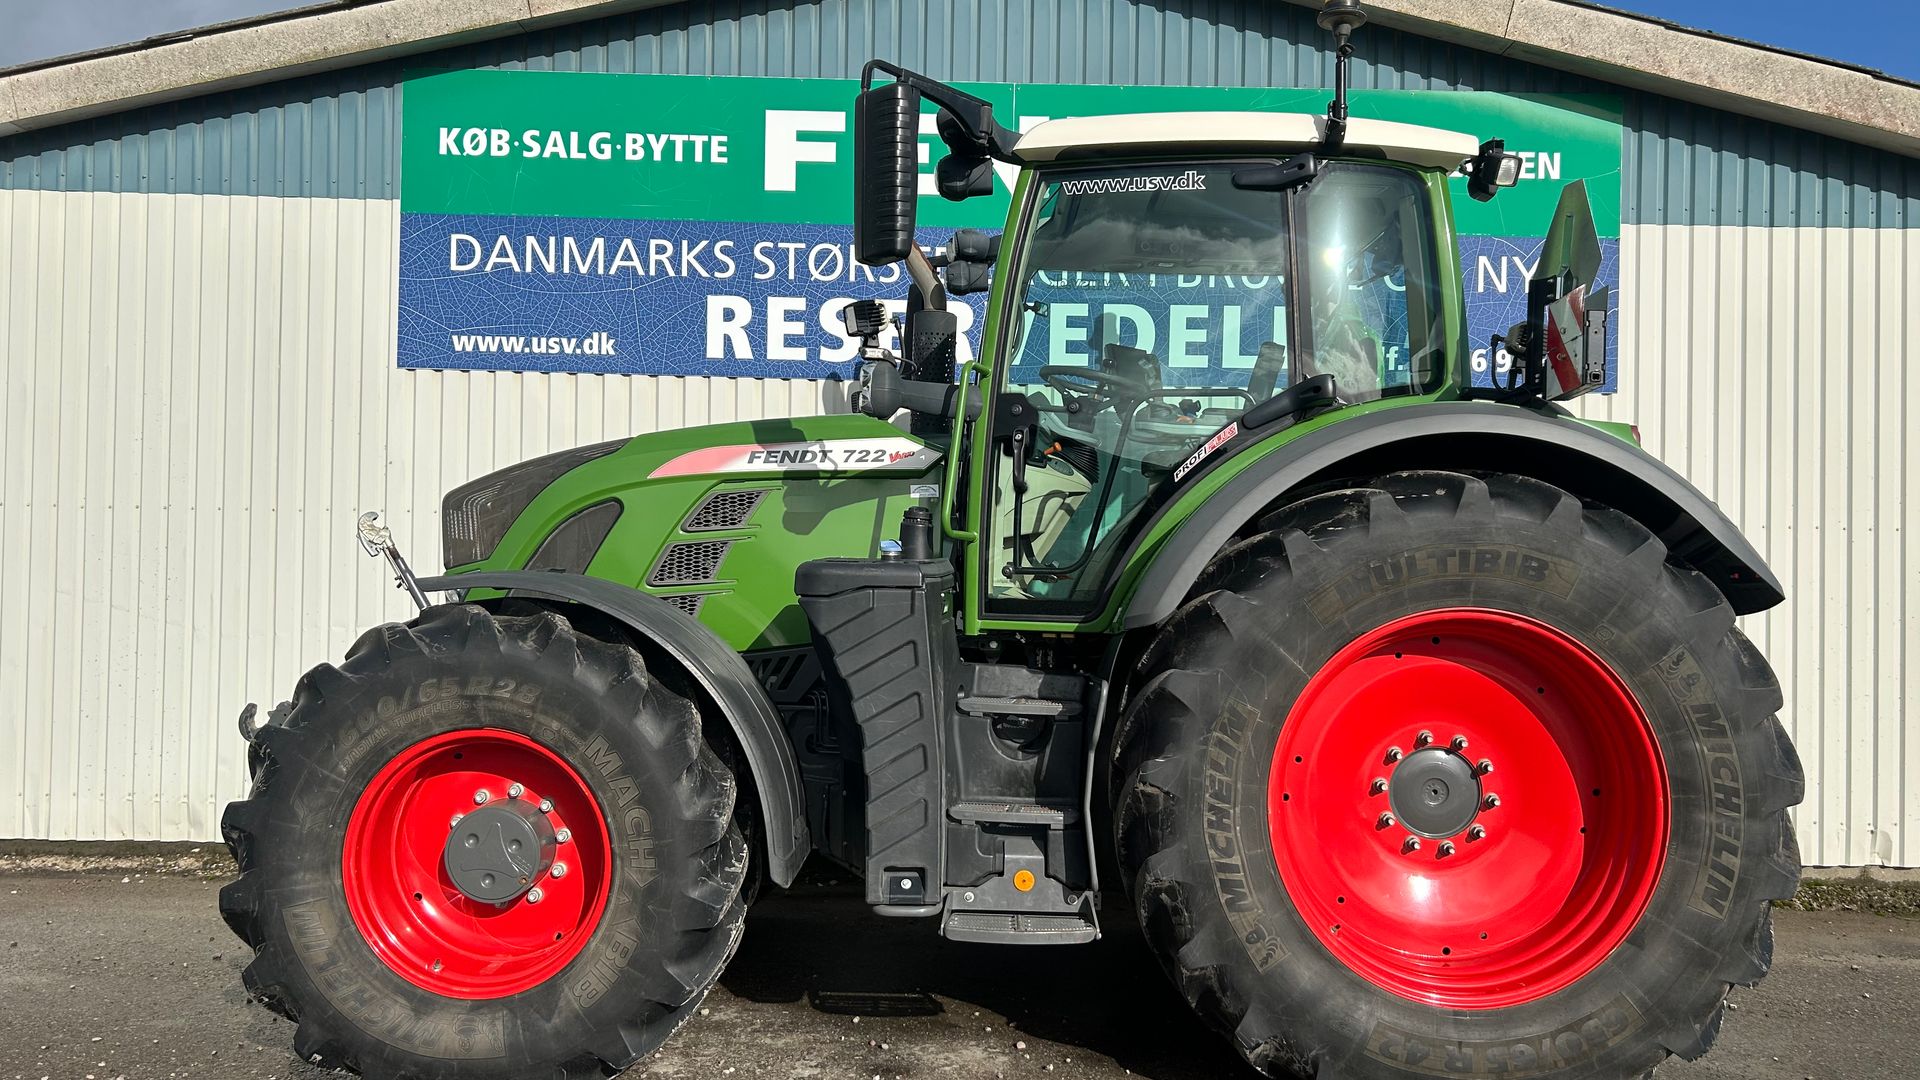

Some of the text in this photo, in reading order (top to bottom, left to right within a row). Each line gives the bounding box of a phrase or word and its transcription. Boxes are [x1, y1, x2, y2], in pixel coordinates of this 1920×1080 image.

[1062, 170, 1206, 196] www.usv.dk
[449, 234, 736, 279] DANMARKS
[451, 332, 616, 356] www.usv.dk
[747, 449, 834, 464] FENDT
[843, 449, 885, 463] 722
[583, 735, 657, 870] MACH
[1206, 698, 1252, 913] MICHELIN
[1689, 702, 1743, 918] MICHELIN
